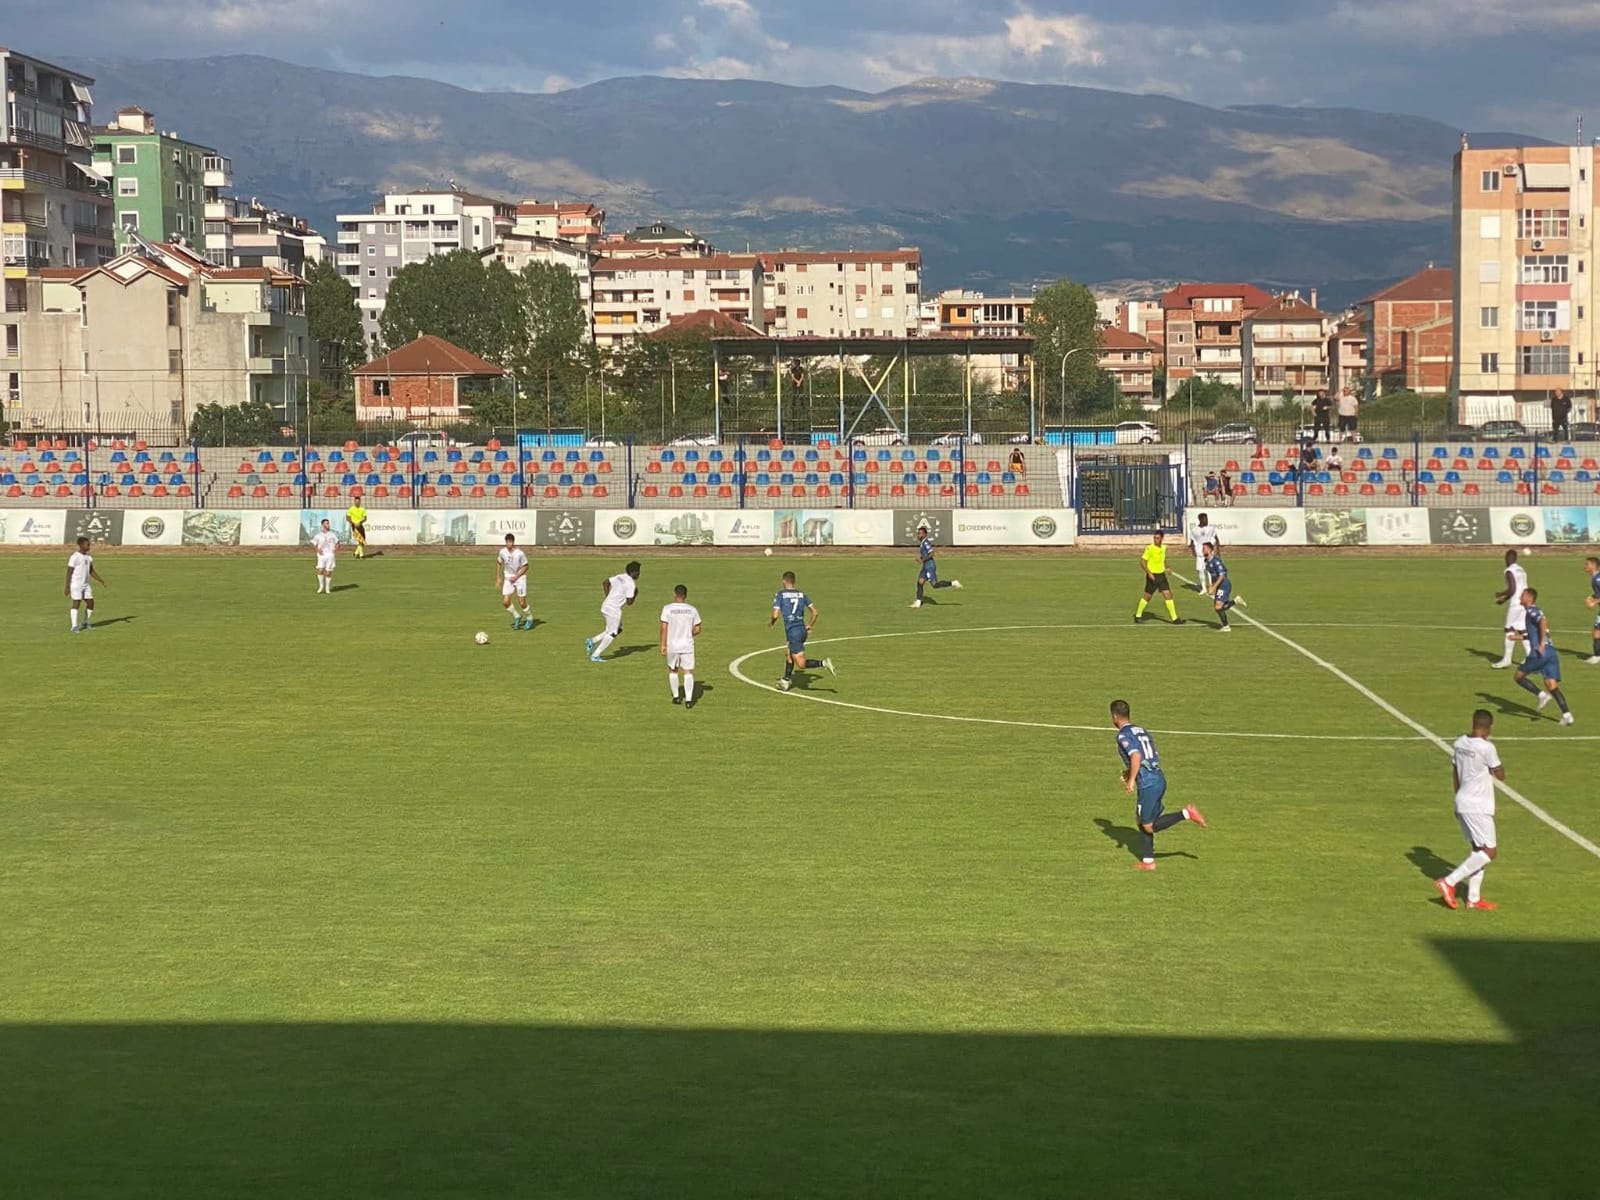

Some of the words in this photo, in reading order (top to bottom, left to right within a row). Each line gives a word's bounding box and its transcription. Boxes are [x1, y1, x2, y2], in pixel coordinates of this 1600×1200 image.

[500, 520, 526, 530] UNICO
[790, 598, 799, 614] 7
[1138, 736, 1153, 759] 11
